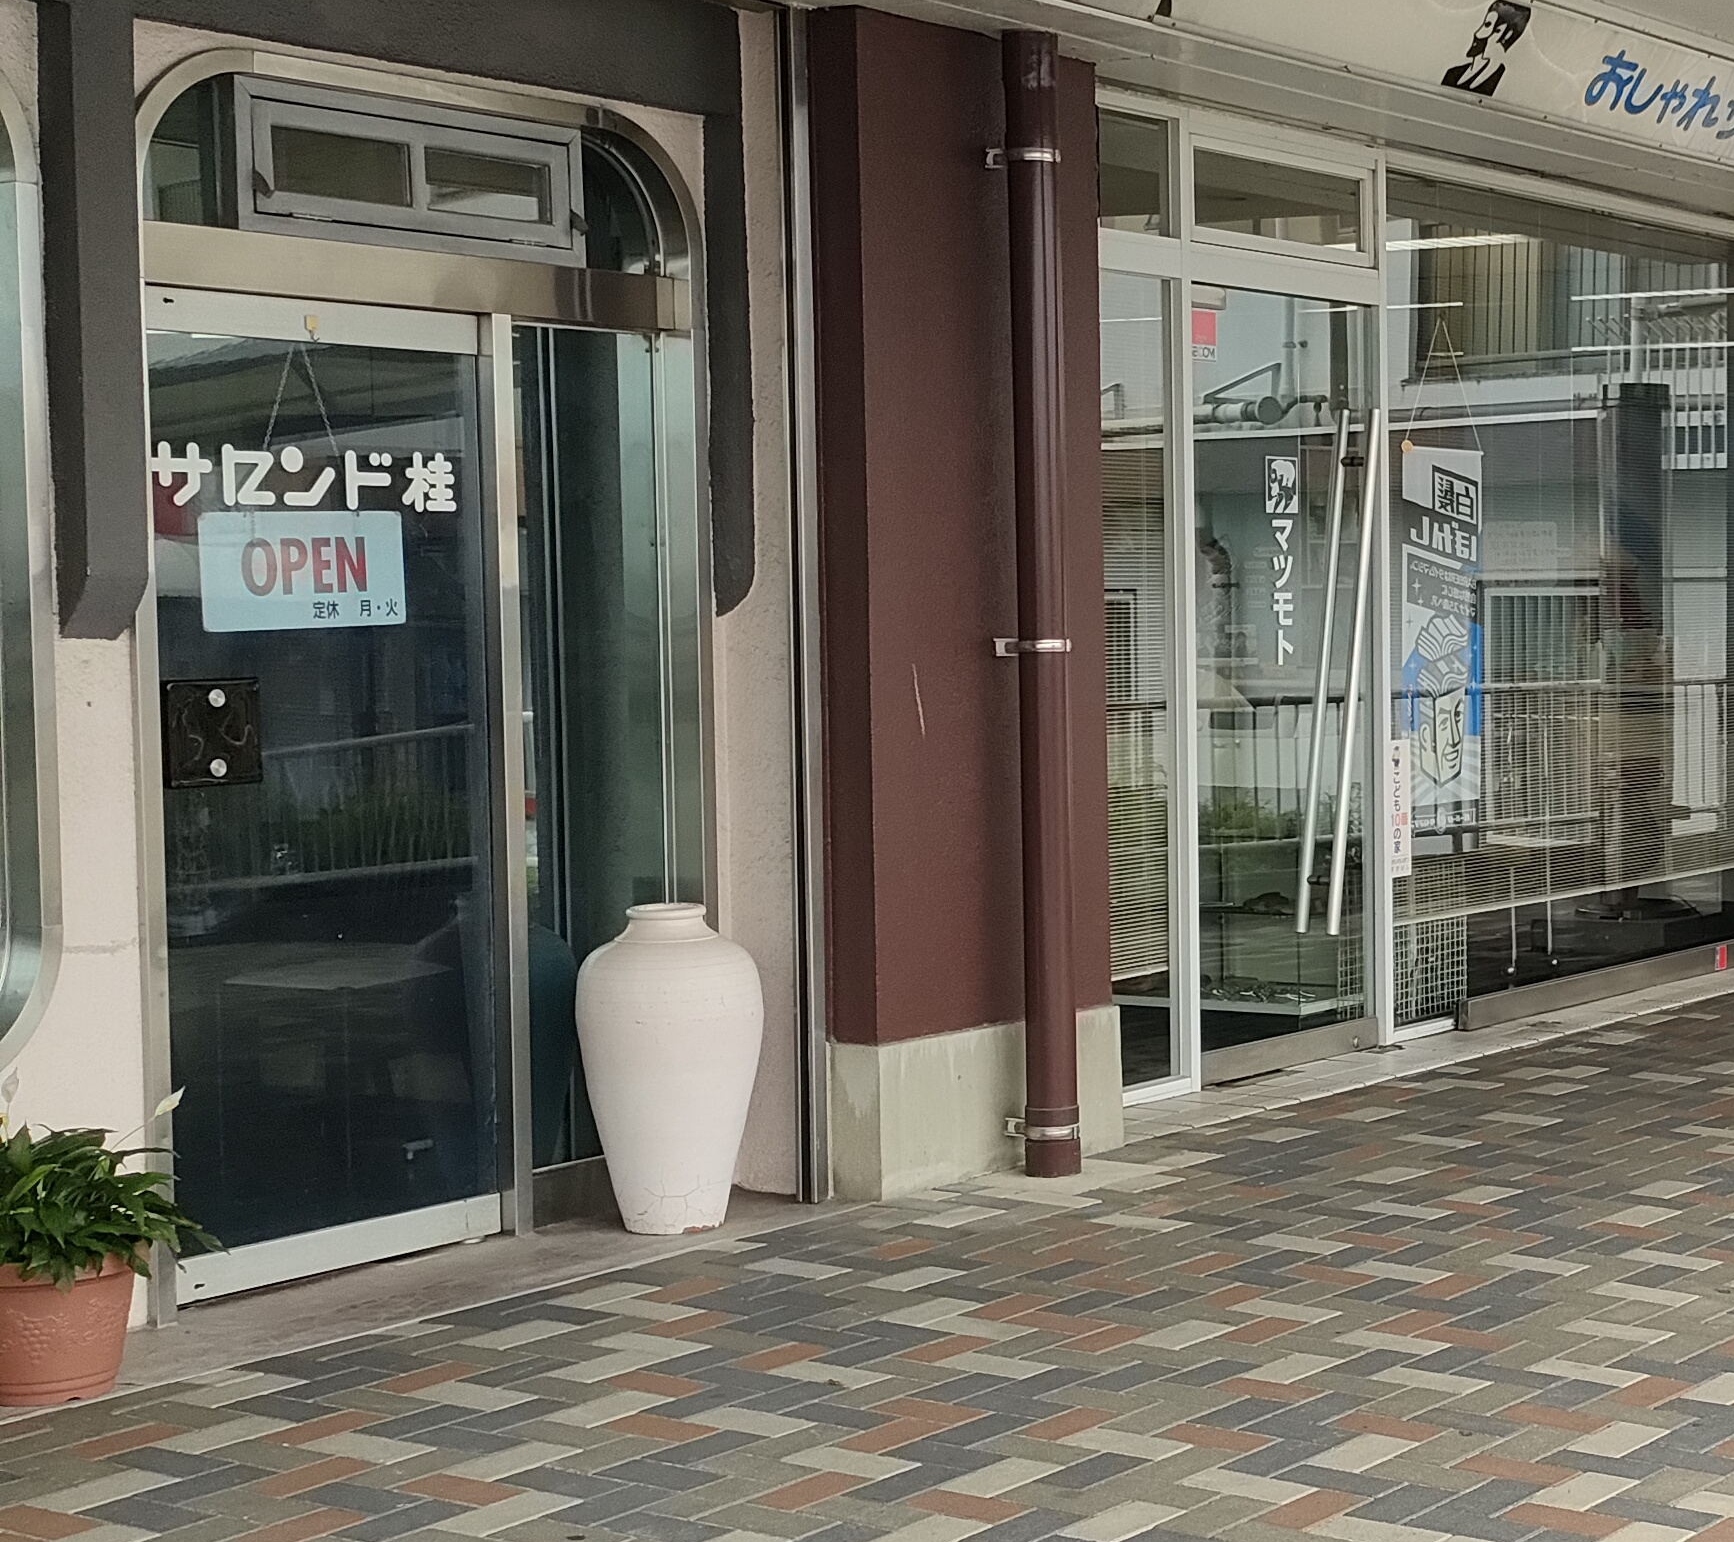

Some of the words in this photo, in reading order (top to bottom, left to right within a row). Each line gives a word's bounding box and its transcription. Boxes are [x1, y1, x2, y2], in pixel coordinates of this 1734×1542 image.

[241, 536, 368, 597] OPEN
[1271, 519, 1294, 666] マツモト
[312, 600, 340, 620] 定休
[359, 598, 399, 618] 月・火
